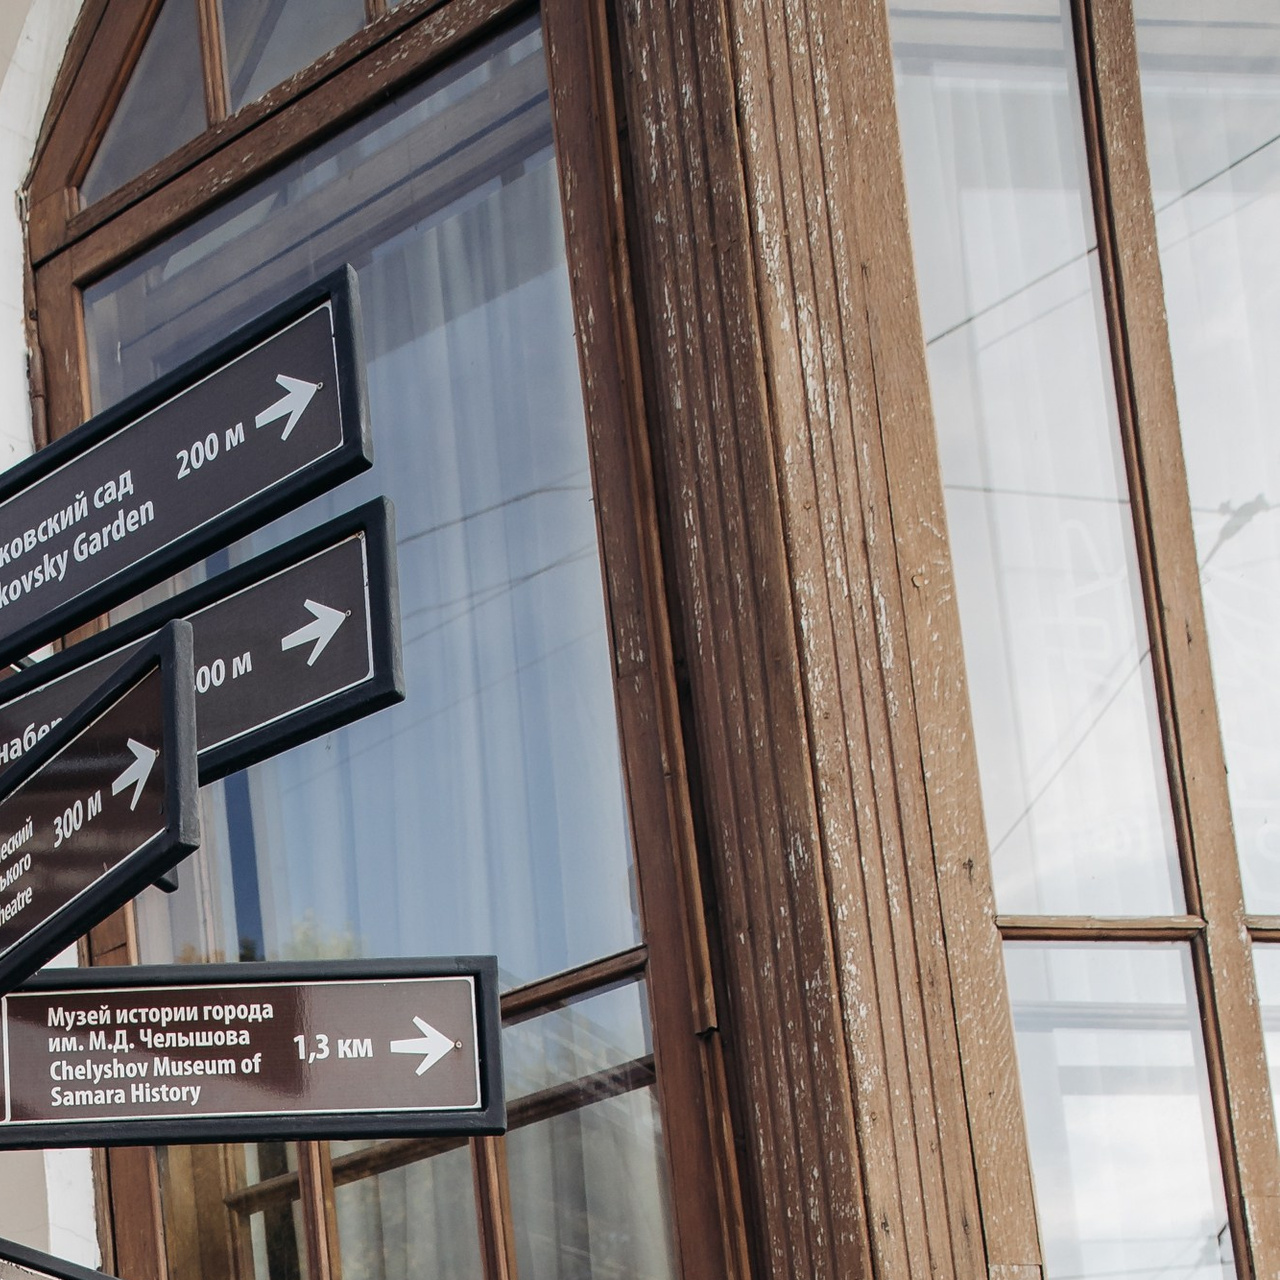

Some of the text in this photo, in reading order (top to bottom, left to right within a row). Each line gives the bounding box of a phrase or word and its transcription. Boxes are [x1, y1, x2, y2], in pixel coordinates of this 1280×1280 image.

[176, 422, 245, 480] 200 м
[94, 470, 134, 508] сад
[73, 501, 154, 562] Garden
[194, 651, 252, 693] 00 м
[54, 790, 102, 848] 300 м
[48, 1004, 273, 1031] Музей истории города
[49, 1028, 250, 1054] им. М.Д. Челышова
[294, 1034, 373, 1064] 1,3 км
[50, 1053, 262, 1084] Chelyshov Museum of
[51, 1083, 201, 1106] Samara History
